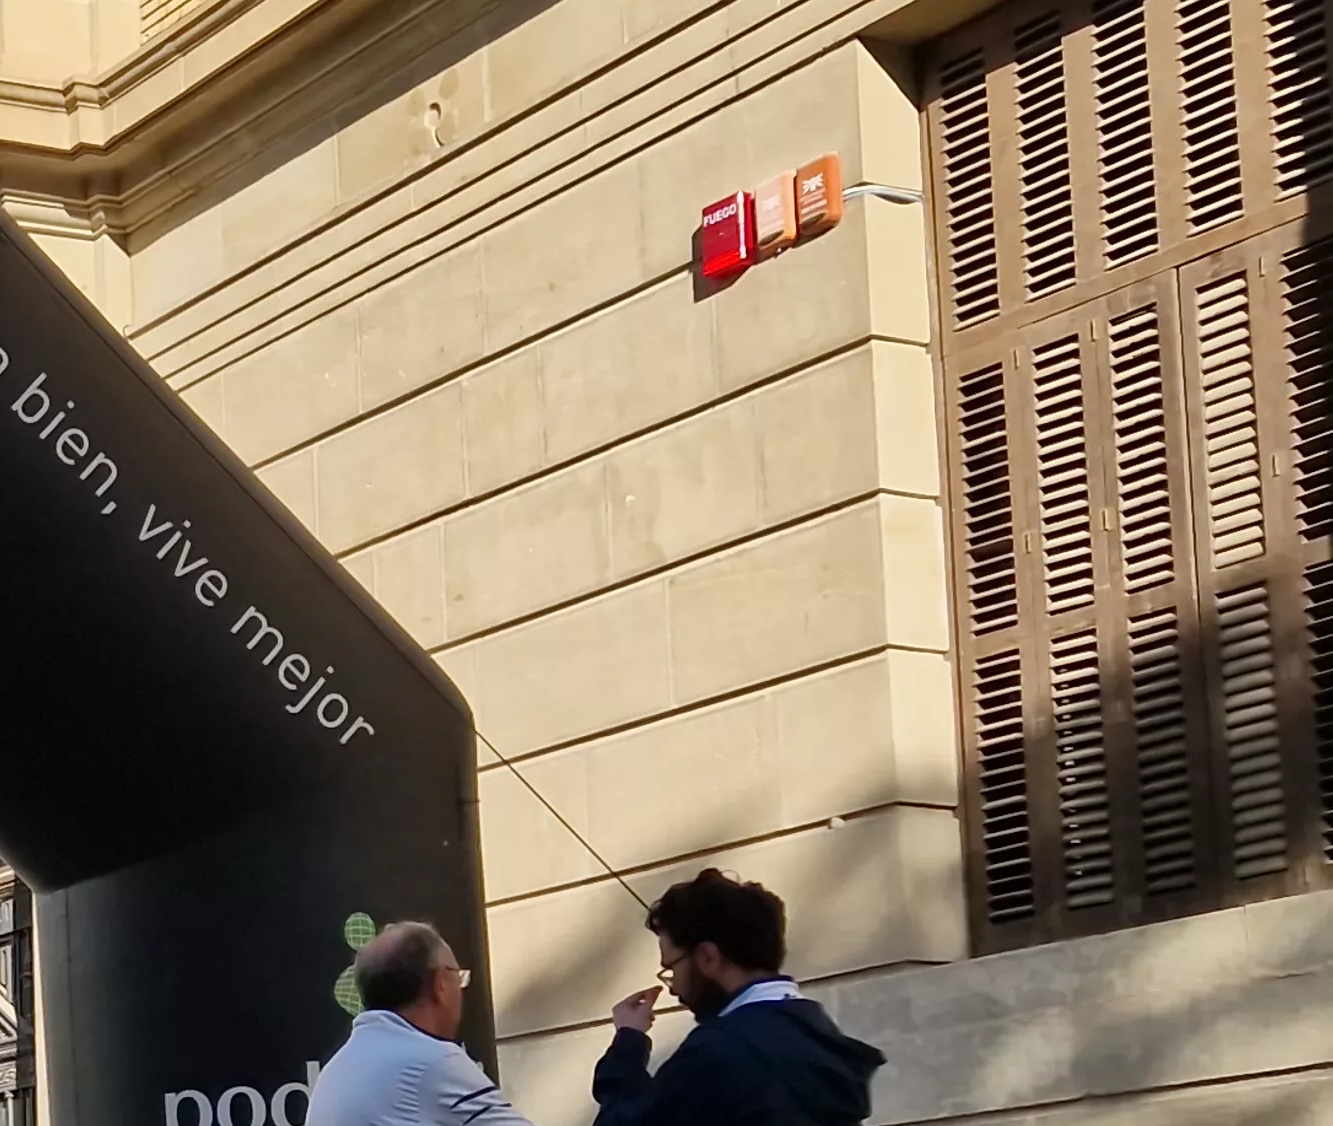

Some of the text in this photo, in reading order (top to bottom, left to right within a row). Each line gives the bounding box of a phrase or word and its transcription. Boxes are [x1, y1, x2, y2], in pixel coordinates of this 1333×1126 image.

[703, 203, 737, 228] FUEGO
[10, 373, 119, 515] bien,
[137, 503, 230, 608] vive
[230, 605, 375, 746] mejor
